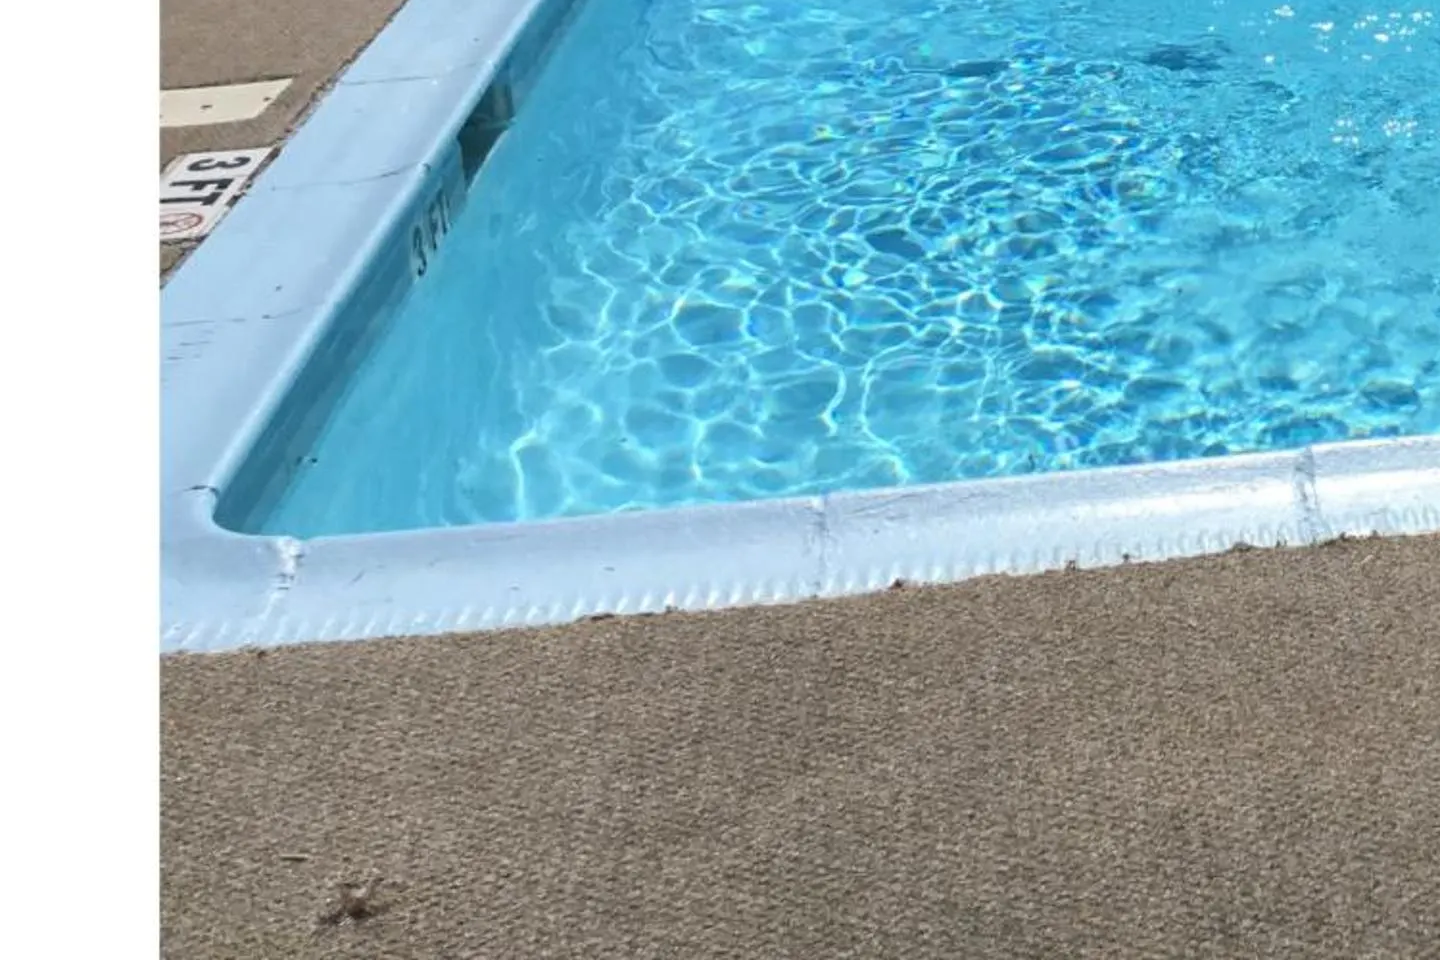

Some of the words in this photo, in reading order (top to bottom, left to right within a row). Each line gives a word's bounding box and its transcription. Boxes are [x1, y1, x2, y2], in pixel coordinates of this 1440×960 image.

[187, 156, 251, 172] 3
[159, 178, 234, 206] FT
[412, 225, 427, 277] 3
[428, 187, 450, 252] FT
